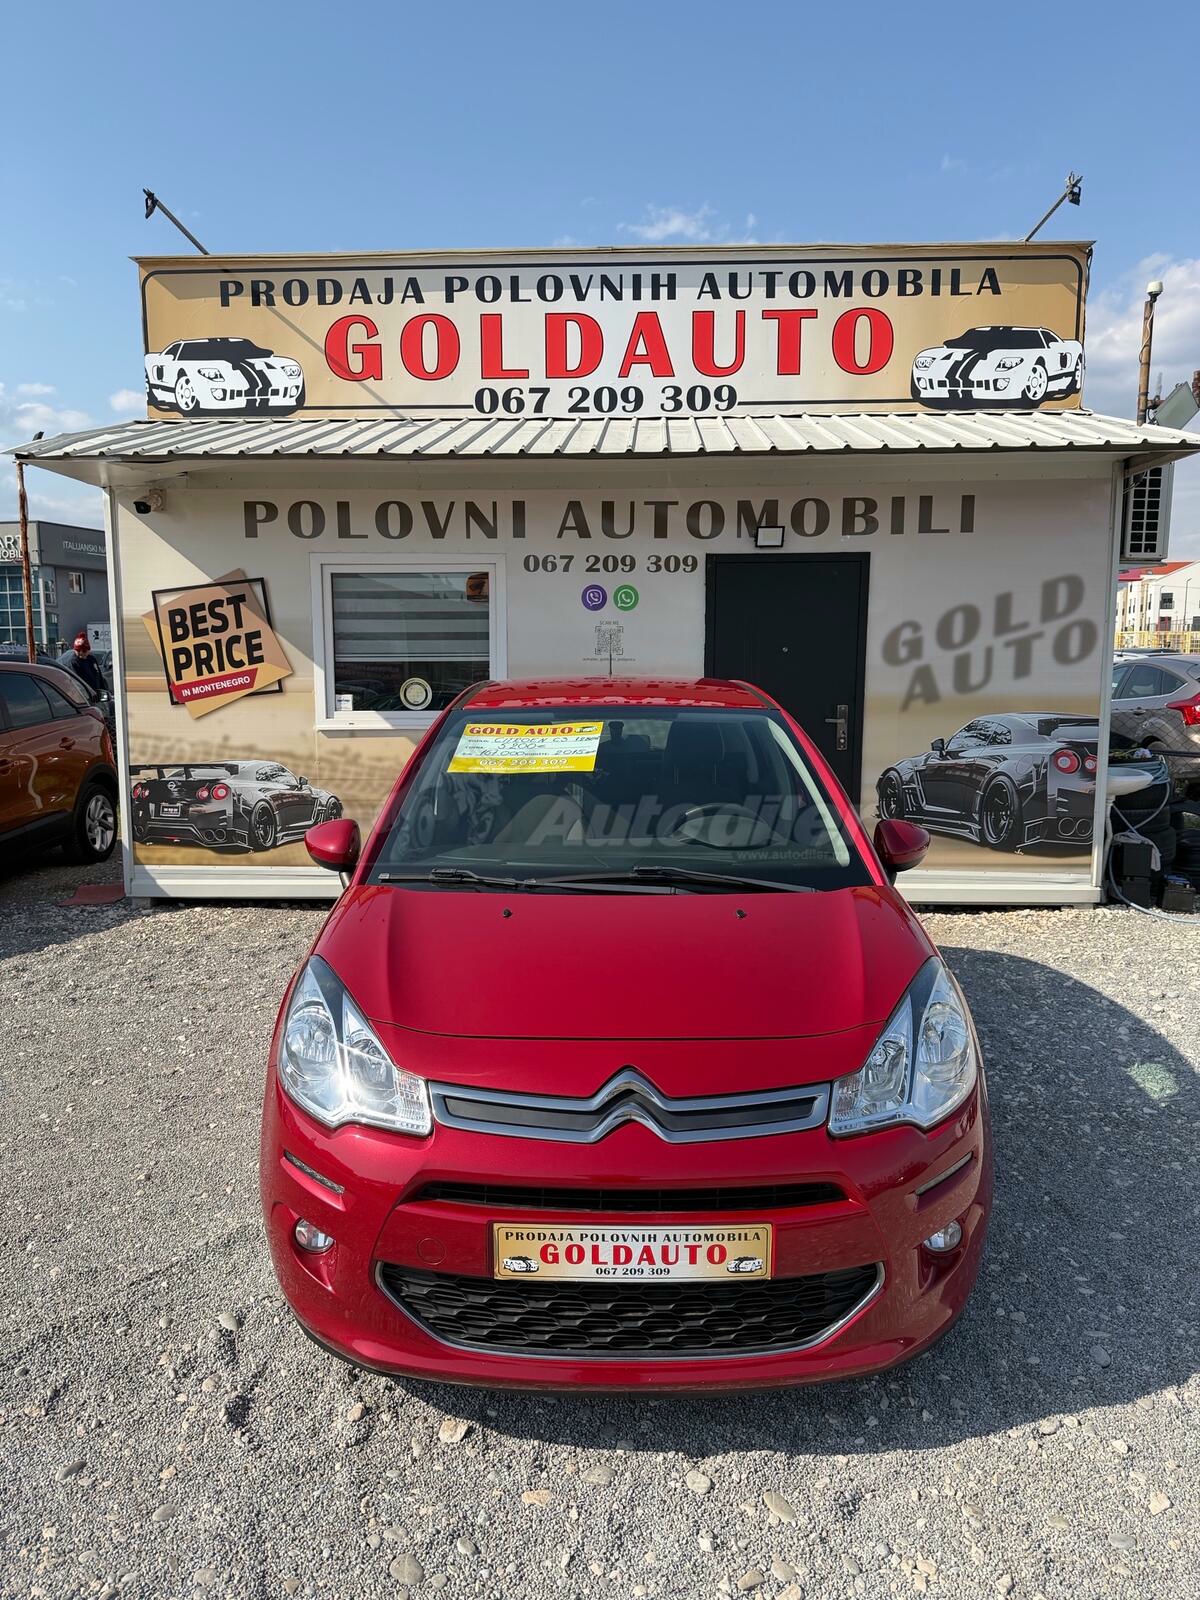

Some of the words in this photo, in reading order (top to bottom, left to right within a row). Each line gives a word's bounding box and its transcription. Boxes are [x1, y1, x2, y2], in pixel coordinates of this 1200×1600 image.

[219, 276, 424, 307] PRODAJA
[445, 272, 675, 304] POLOVNIH
[696, 267, 1001, 300] AUTOMOBILA
[324, 306, 894, 382] GOLDAUTO
[474, 386, 552, 415] 067
[567, 385, 645, 414] 209
[659, 383, 738, 413] 309
[243, 500, 526, 539] POLOVNI
[557, 494, 976, 539] AUTOMOBILI
[523, 554, 575, 574] 067
[584, 554, 637, 574] 209
[646, 553, 698, 573] 309
[167, 593, 247, 643] BEST
[881, 573, 1085, 667] GOLD
[172, 630, 265, 682] PRICE
[900, 618, 1098, 711] AUTO
[181, 688, 191, 697] IN
[192, 675, 251, 695] MONTENEGRO
[468, 726, 519, 735] GOLD
[524, 726, 574, 735] AUTO
[479, 759, 507, 767] 067
[505, 1231, 574, 1242] PRODAJA
[580, 1232, 657, 1243] POLOVNIH
[662, 1231, 761, 1242] AUTOMOBILA
[539, 1243, 727, 1266] GOLDAUTO
[595, 1267, 617, 1275] 067
[621, 1267, 644, 1275] 209
[647, 1267, 671, 1275] 309
